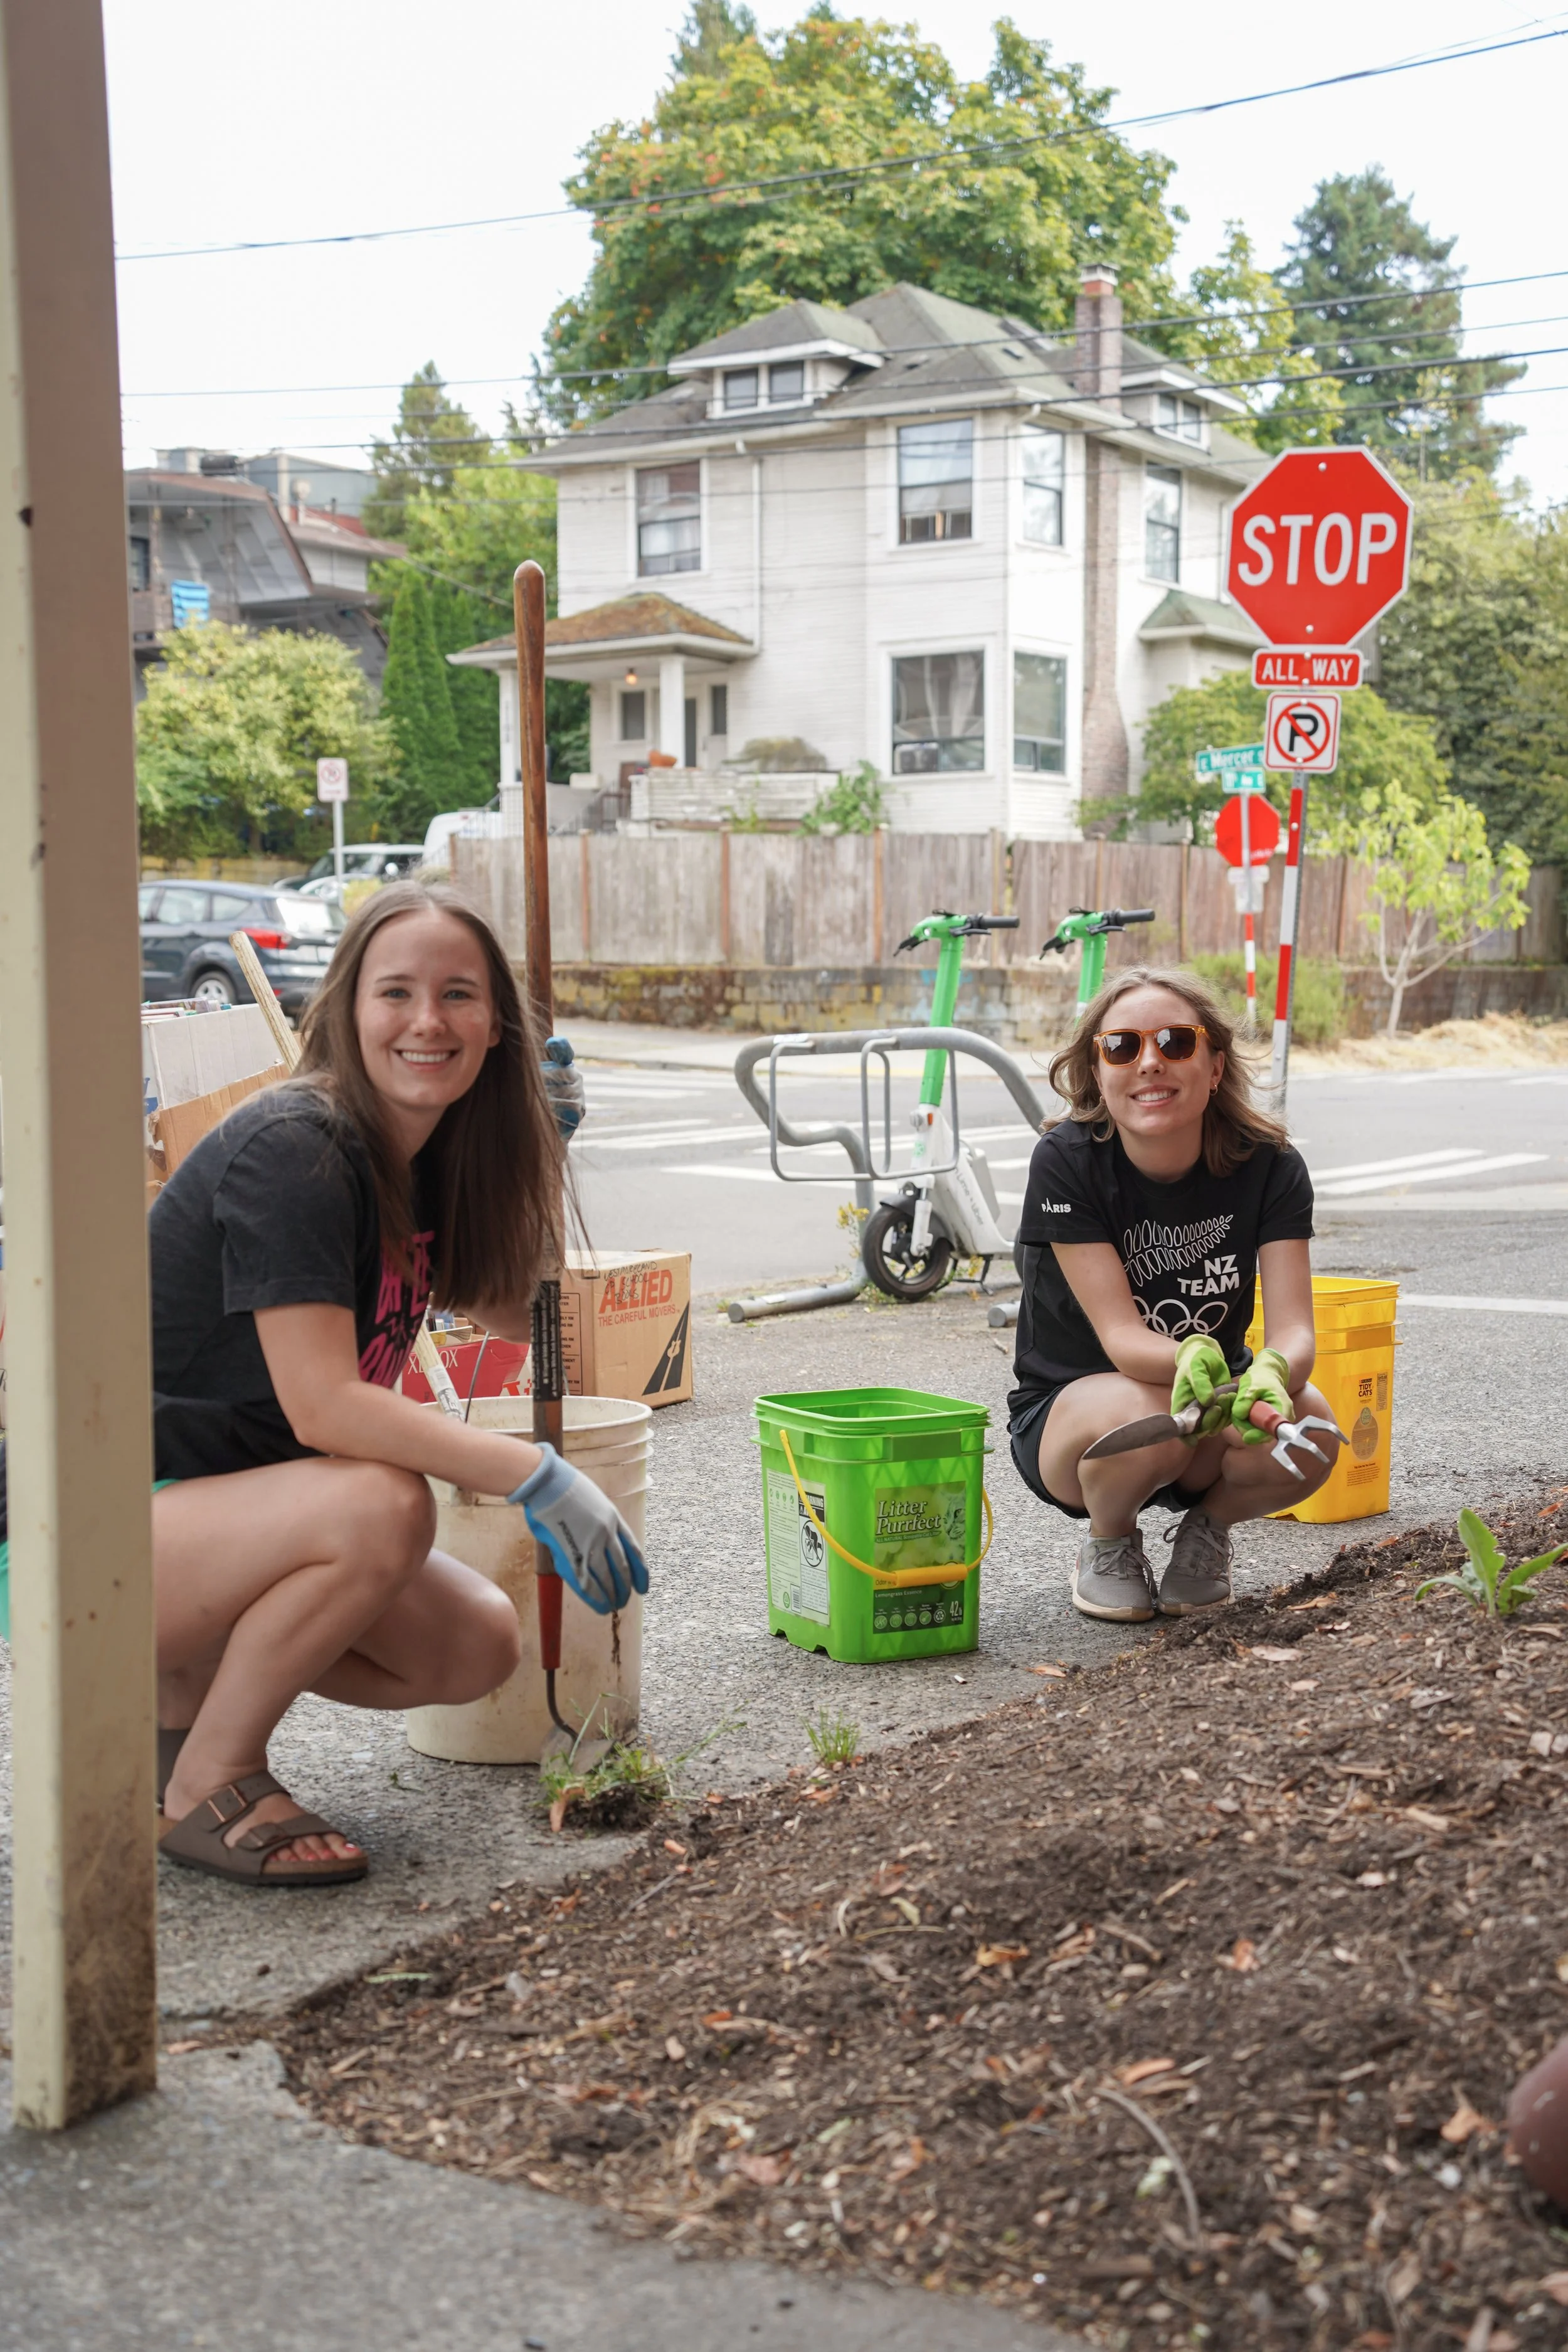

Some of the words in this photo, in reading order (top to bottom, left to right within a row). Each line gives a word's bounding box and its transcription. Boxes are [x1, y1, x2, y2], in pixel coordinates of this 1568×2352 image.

[1237, 512, 1397, 586] STOP
[1261, 658, 1299, 681] ALL
[1313, 658, 1353, 682] WAY
[1289, 713, 1318, 751] P
[1041, 1197, 1071, 1212] PARIS
[1204, 1254, 1237, 1277] NZ
[598, 1269, 672, 1314] ALLIED
[1177, 1273, 1239, 1296] TEAM
[598, 1315, 613, 1327] THE
[615, 1309, 647, 1325] CAREFUL
[649, 1305, 676, 1318] MOVERS
[877, 1500, 927, 1518] Litter
[876, 1513, 941, 1535] Purrfect
[950, 1601, 959, 1617] 42
